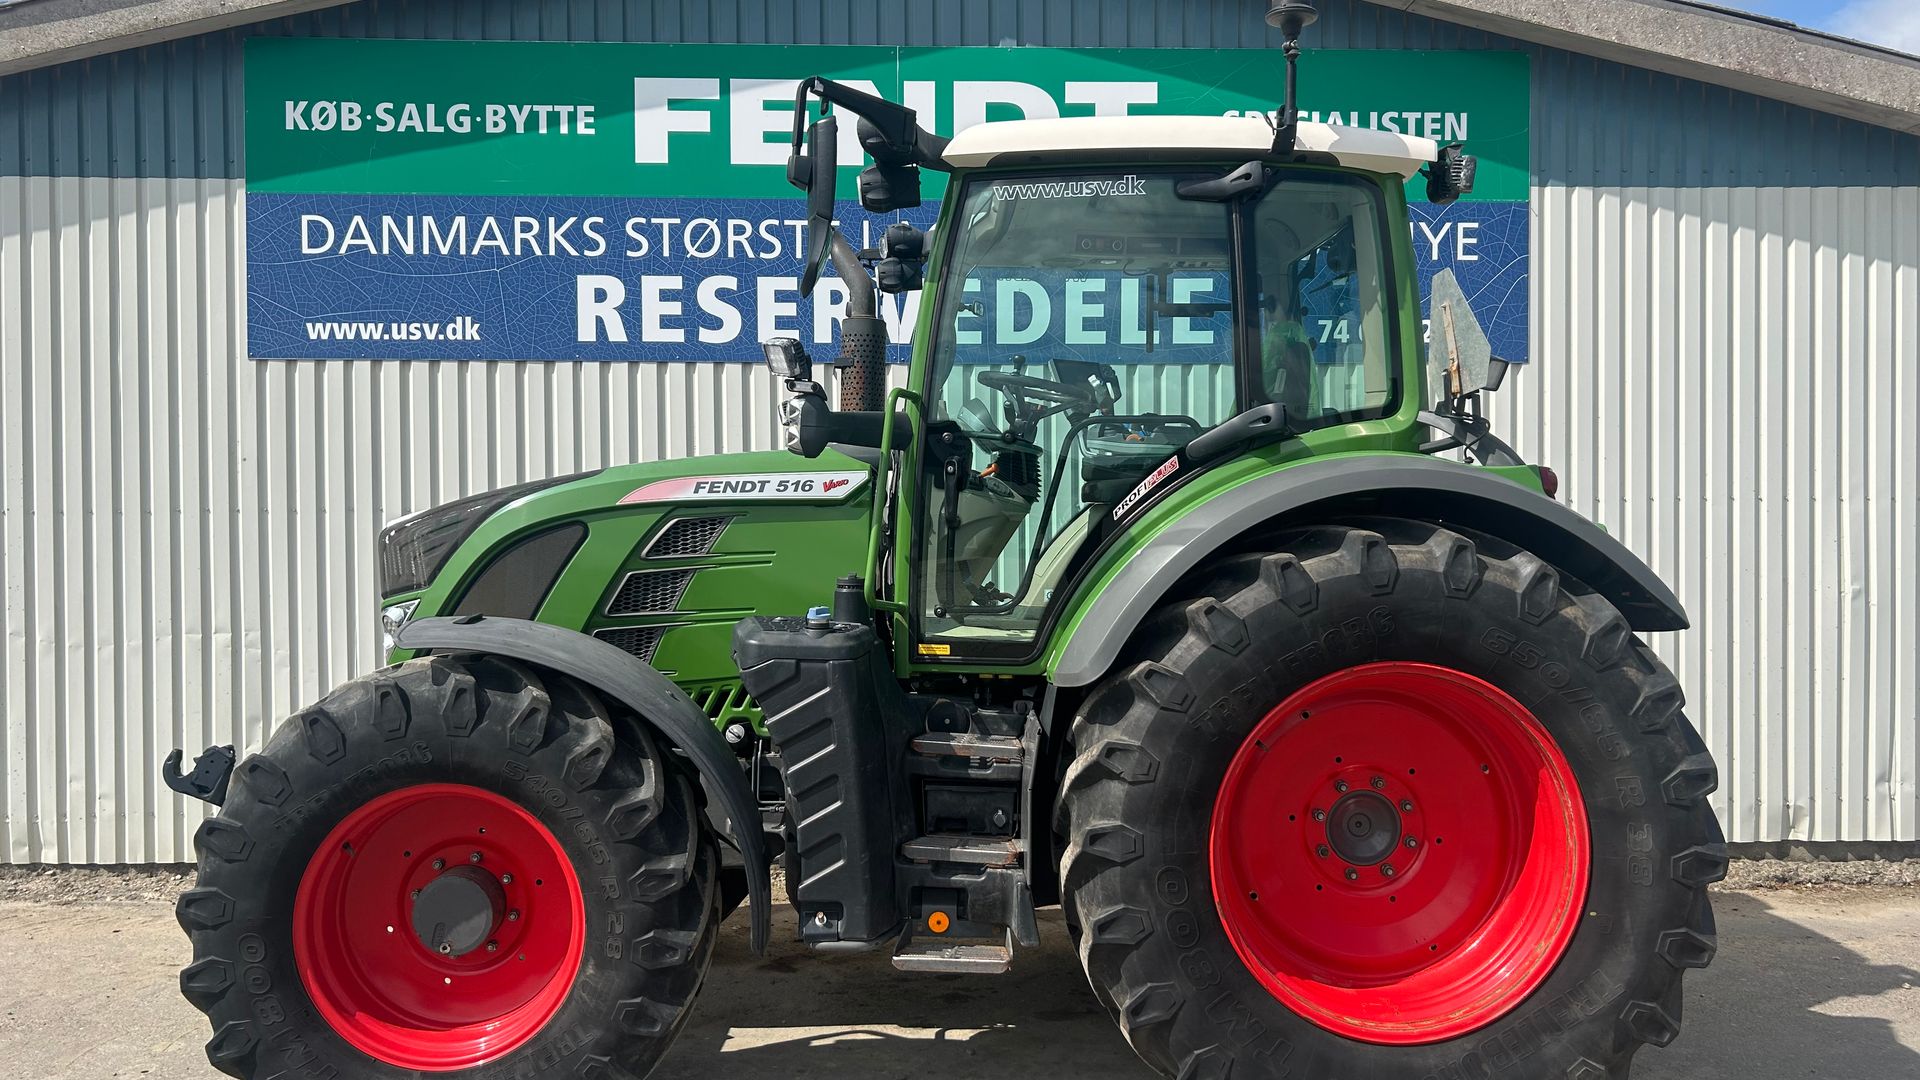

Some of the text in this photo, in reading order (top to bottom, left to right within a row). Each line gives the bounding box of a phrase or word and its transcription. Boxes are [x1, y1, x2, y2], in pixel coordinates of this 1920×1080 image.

[992, 175, 1147, 201] www.usv.dk
[300, 213, 607, 257] DANMARKS
[625, 217, 840, 261] STØRST
[1409, 222, 1479, 261] YE
[306, 316, 481, 342] www.usv.dk
[576, 274, 1215, 346] RESERVEDELE
[1317, 319, 1350, 344] 74
[693, 480, 771, 494] FENDT
[775, 479, 815, 493] 516
[1188, 604, 1396, 743] TREEBORG
[1480, 626, 1655, 888] 650/65 R 38
[502, 758, 625, 961] 540/65 R 28
[1155, 864, 1295, 1079] TM800
[1422, 968, 1625, 1080] TRELLEBO
